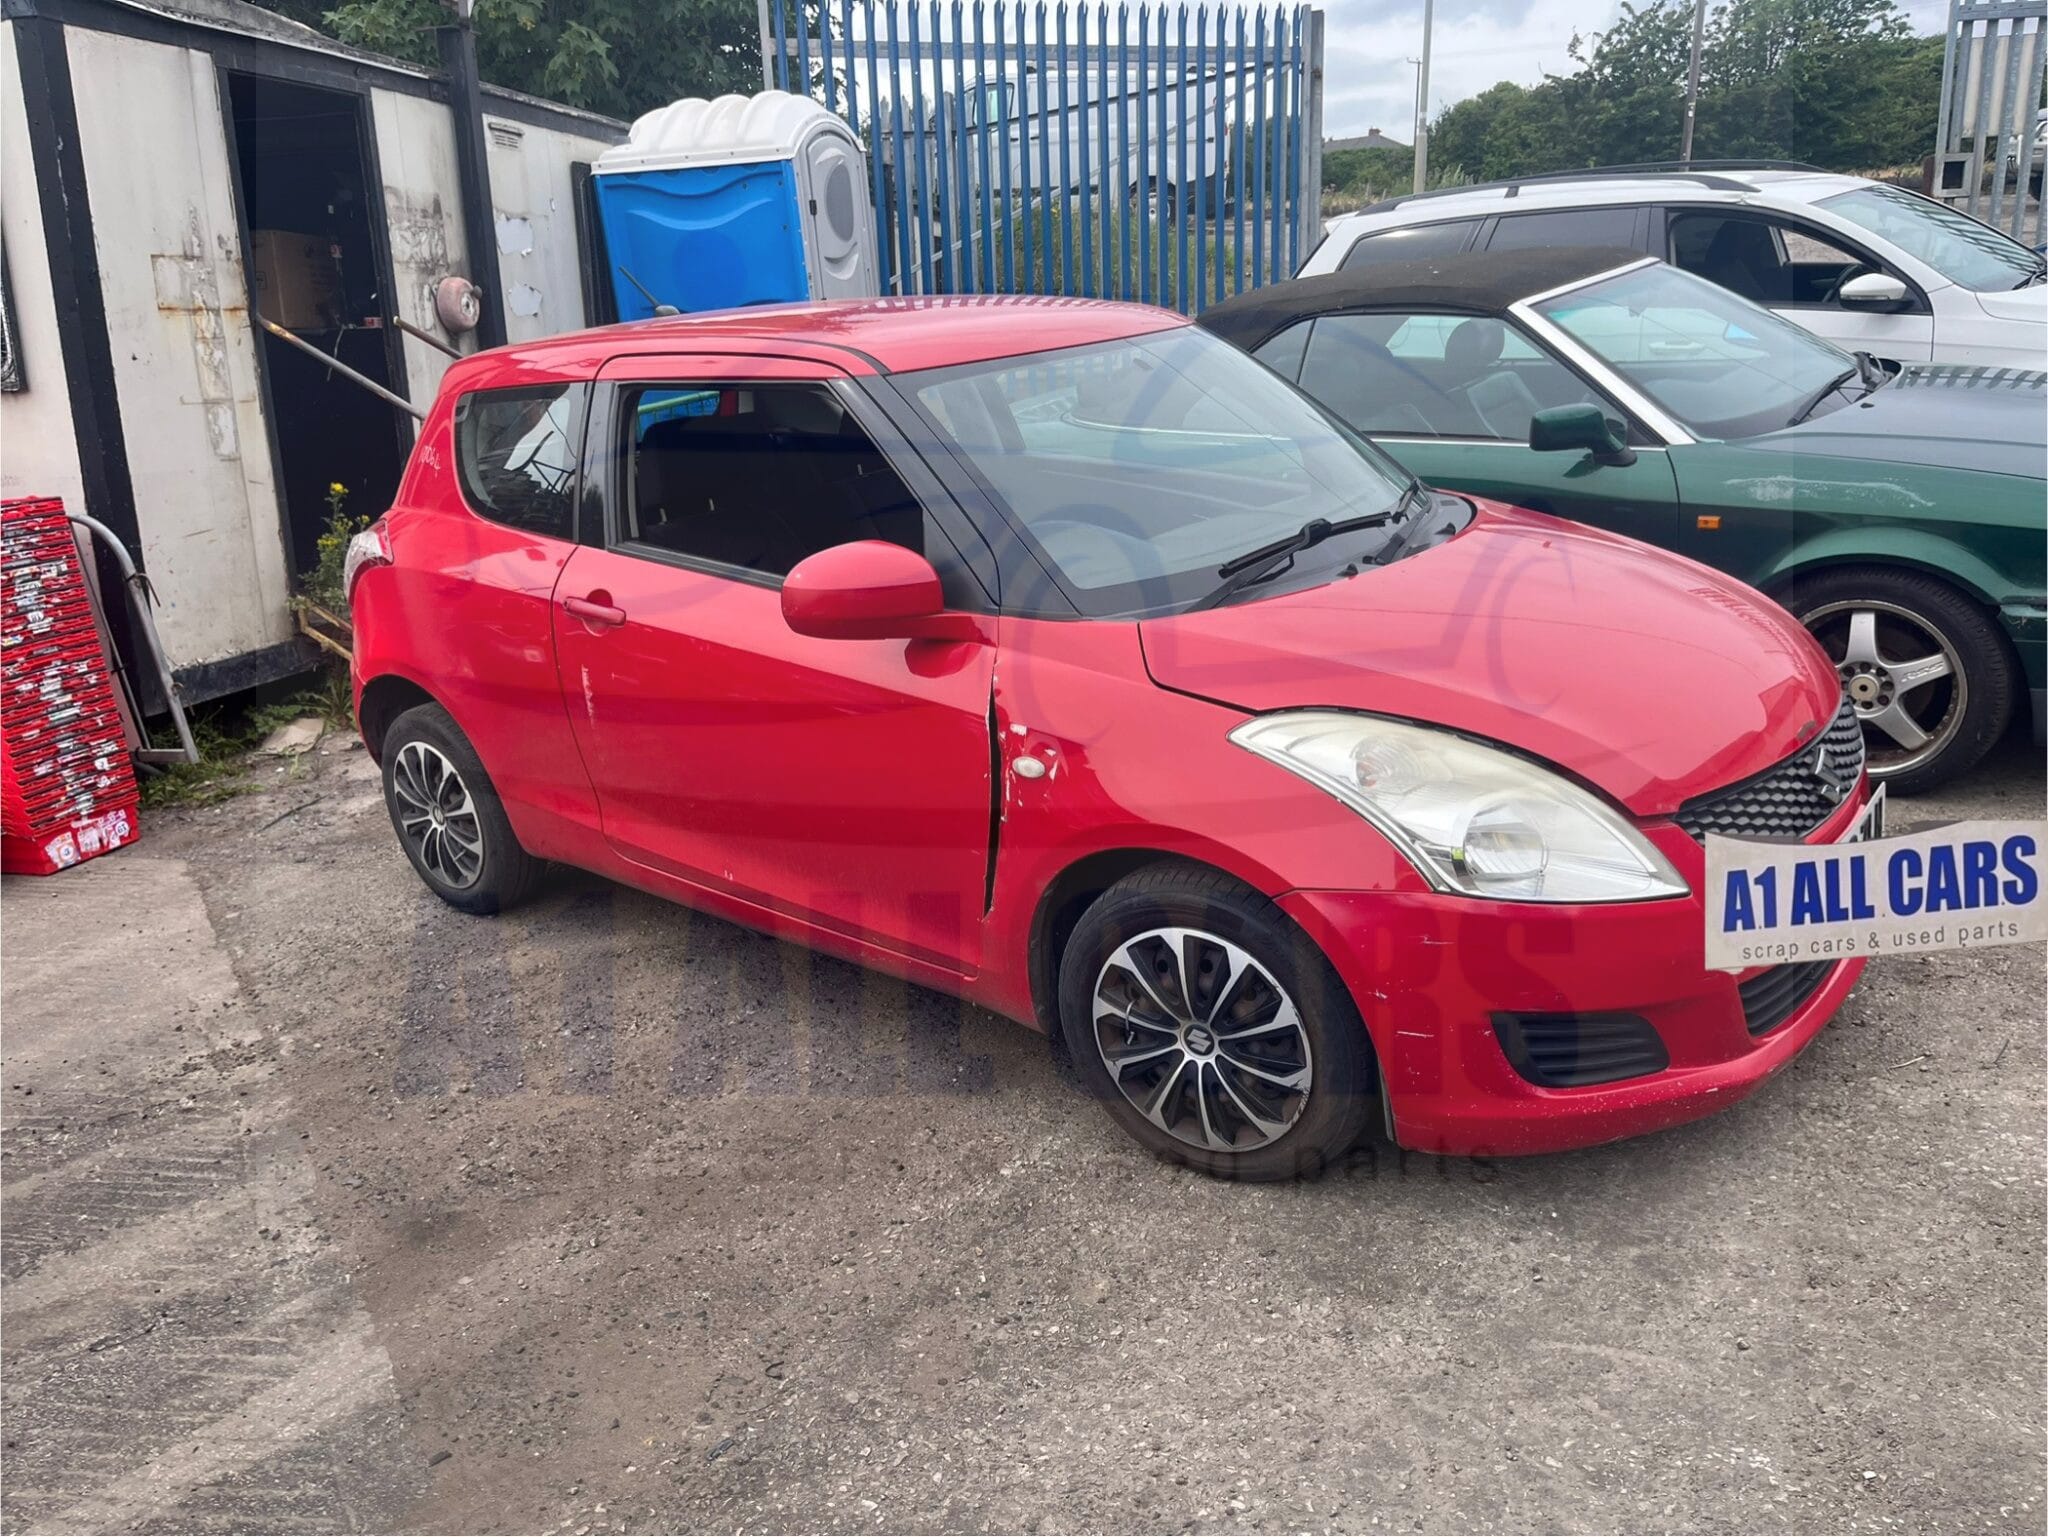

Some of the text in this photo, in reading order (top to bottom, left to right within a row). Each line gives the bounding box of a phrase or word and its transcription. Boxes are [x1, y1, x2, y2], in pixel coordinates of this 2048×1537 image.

[1723, 835, 2039, 933] A1 ALL CARS
[1742, 920, 2019, 960] scrap cars & used parts
